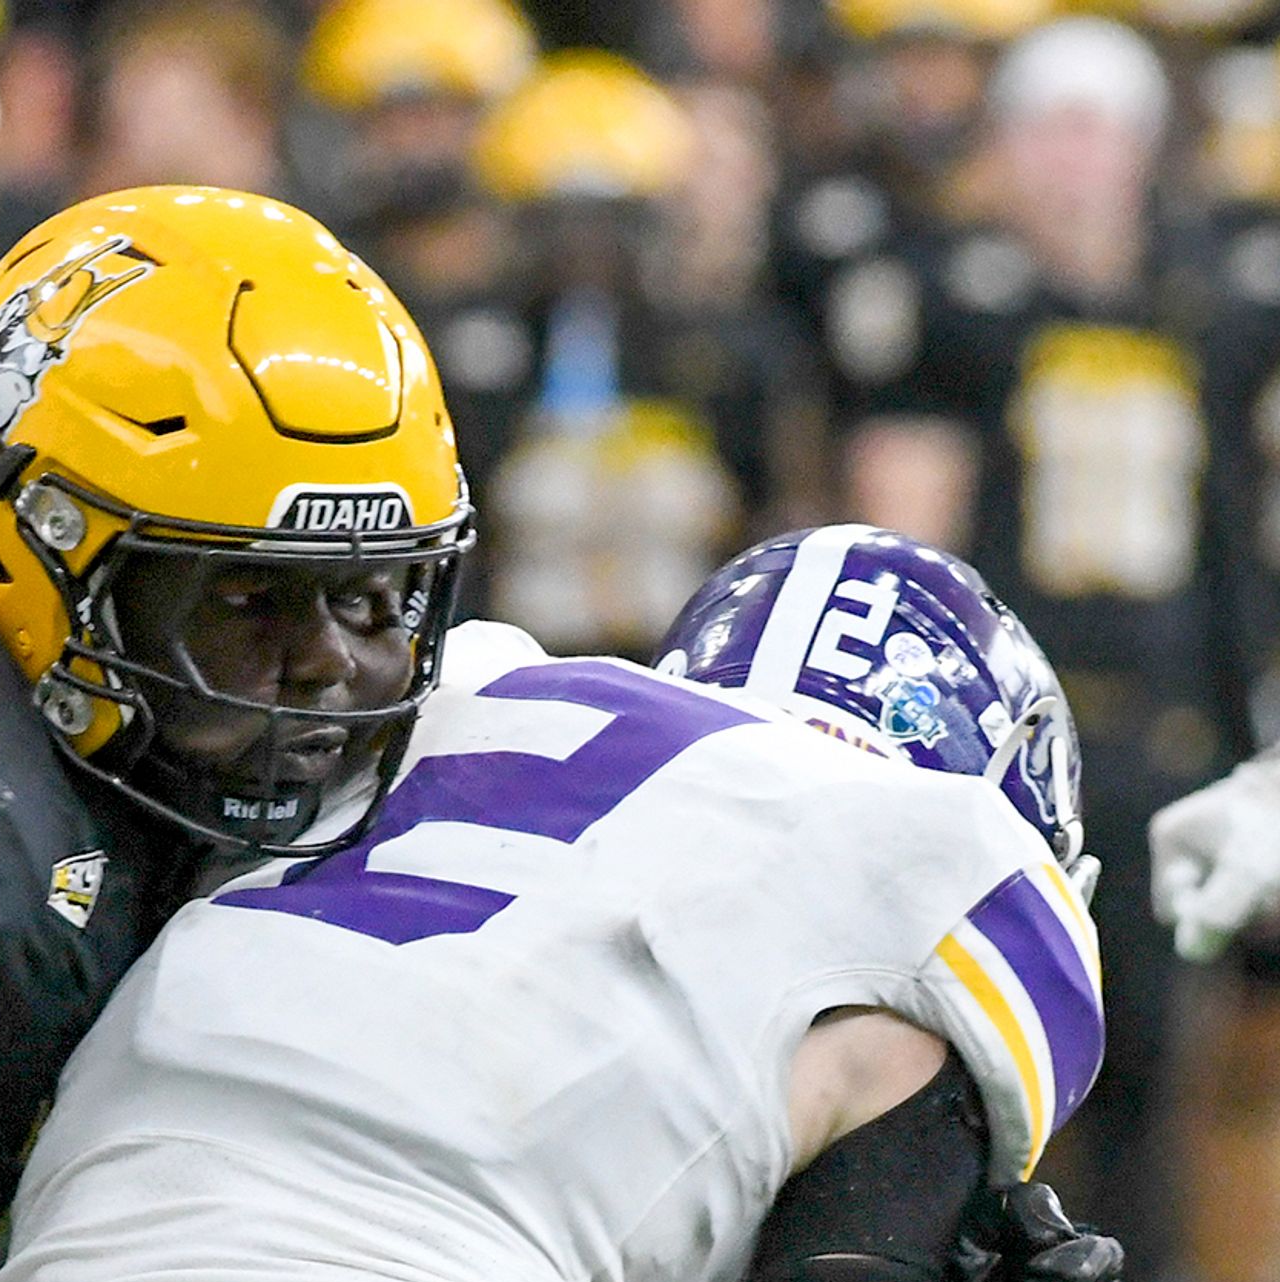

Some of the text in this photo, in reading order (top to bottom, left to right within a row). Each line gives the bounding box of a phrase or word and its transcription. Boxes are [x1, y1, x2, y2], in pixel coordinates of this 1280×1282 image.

[294, 498, 404, 531] IDAHO
[805, 578, 900, 680] 2
[223, 797, 299, 820] Ridell
